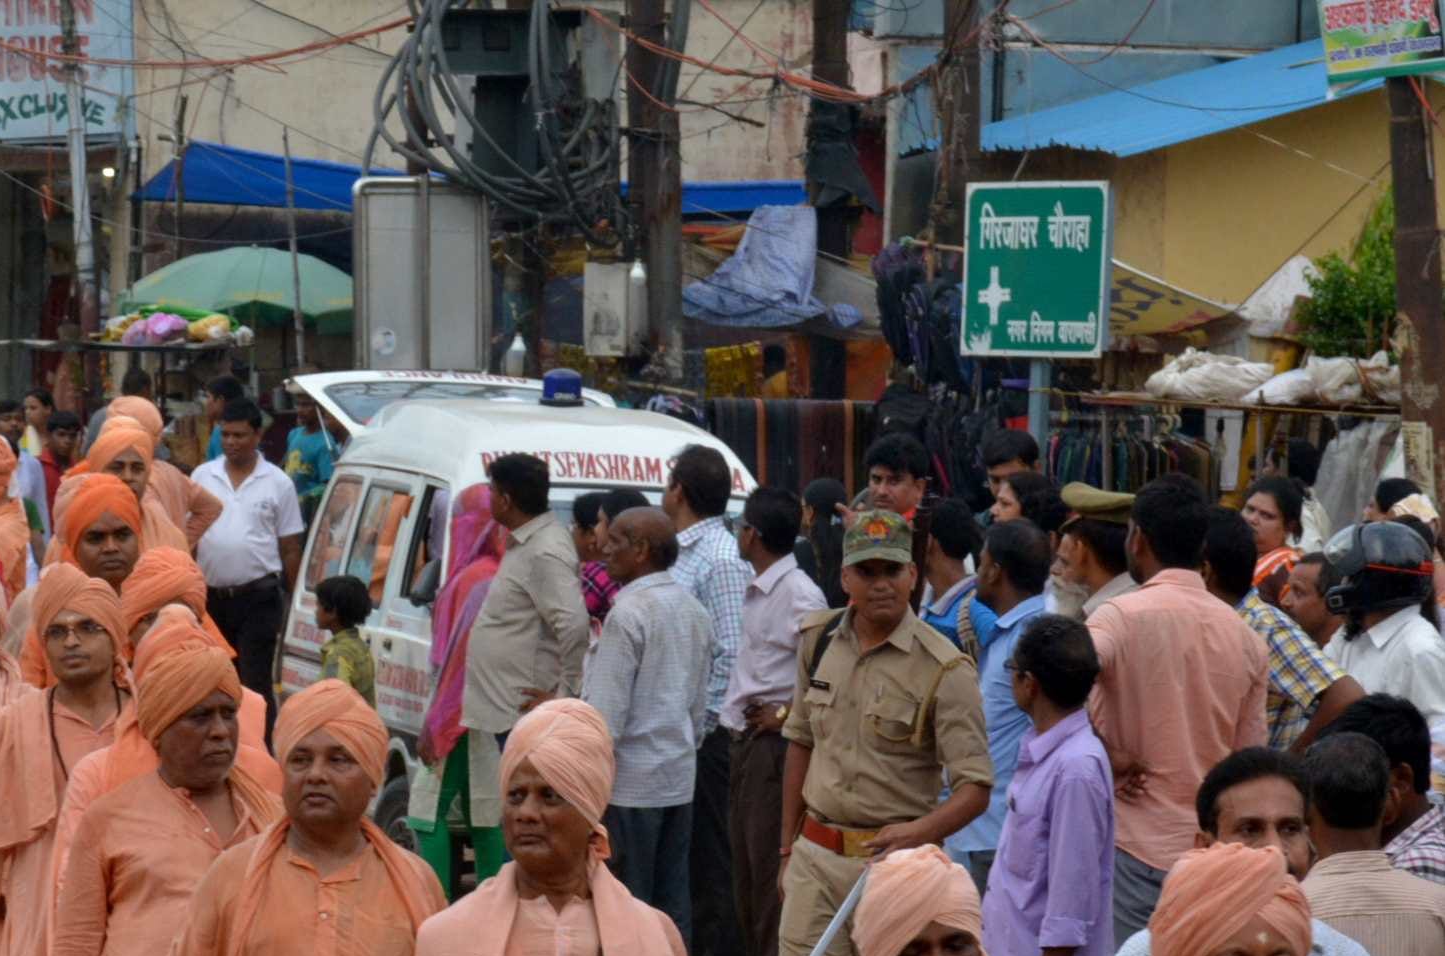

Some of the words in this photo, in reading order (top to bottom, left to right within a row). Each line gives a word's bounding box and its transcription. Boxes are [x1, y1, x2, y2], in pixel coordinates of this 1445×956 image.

[979, 201, 1040, 250] गिरजाघर
[1047, 200, 1092, 253] चौराहा
[1007, 319, 1028, 344] नगर
[1030, 310, 1055, 344] निगम
[1058, 311, 1097, 345] वाराणसी
[555, 451, 662, 484] SEVASHRAM
